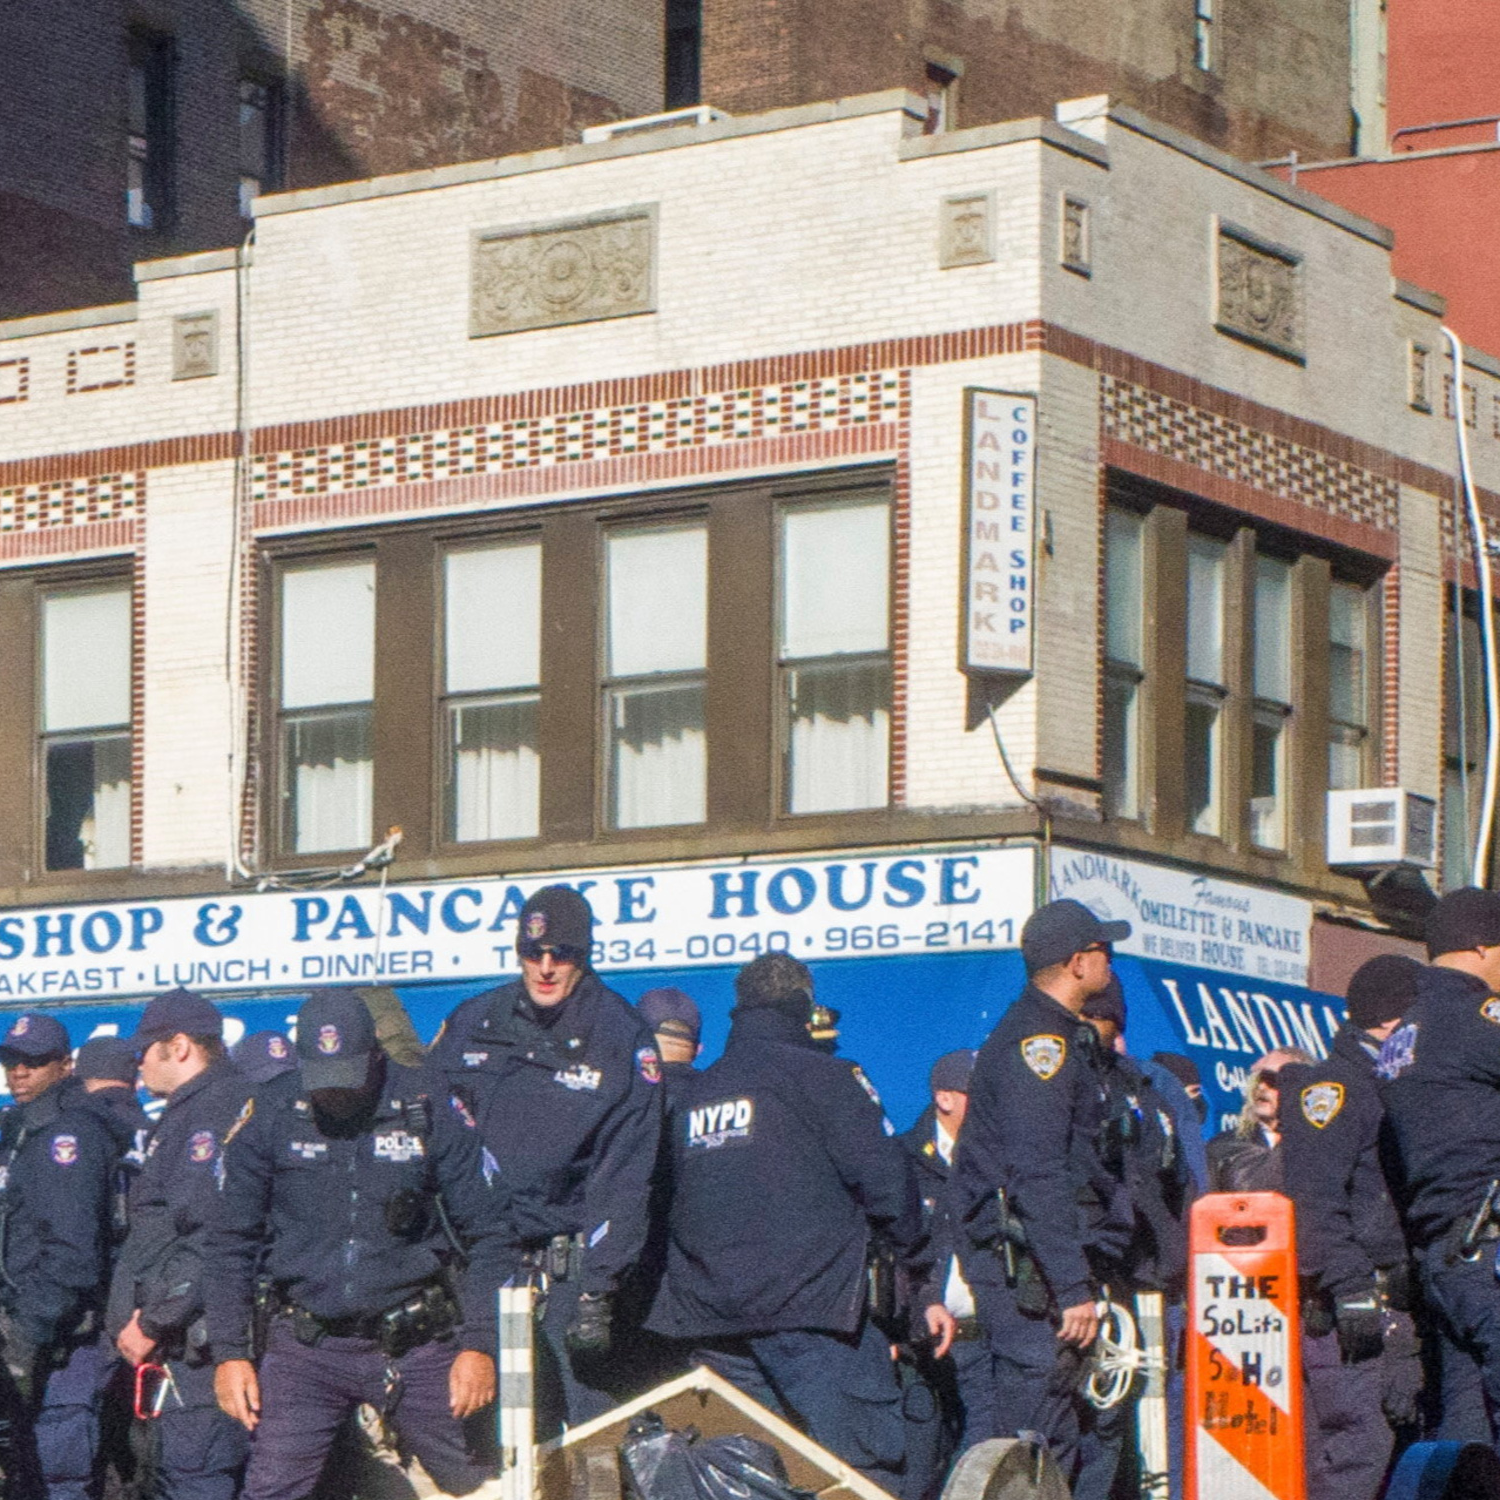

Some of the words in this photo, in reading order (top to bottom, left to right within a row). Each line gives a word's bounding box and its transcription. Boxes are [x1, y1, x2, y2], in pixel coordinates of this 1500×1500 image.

[1011, 407, 1027, 532] COFFEE
[973, 400, 1000, 633] LANDMARK
[1009, 550, 1027, 634] SHOP
[194, 903, 242, 947] &
[291, 876, 657, 942] PANCAE
[709, 857, 982, 919] HOUSE
[1140, 898, 1217, 937] OMELETTE
[1238, 919, 1302, 955] PANCAKE
[154, 959, 271, 986] LUNCH
[301, 951, 434, 978] DINNER
[825, 918, 1017, 951] 966-2141
[1201, 940, 1245, 971] HOUSE
[375, 1136, 423, 1150] POLICE
[689, 1099, 752, 1139] NYPD
[1205, 1275, 1279, 1299] THE
